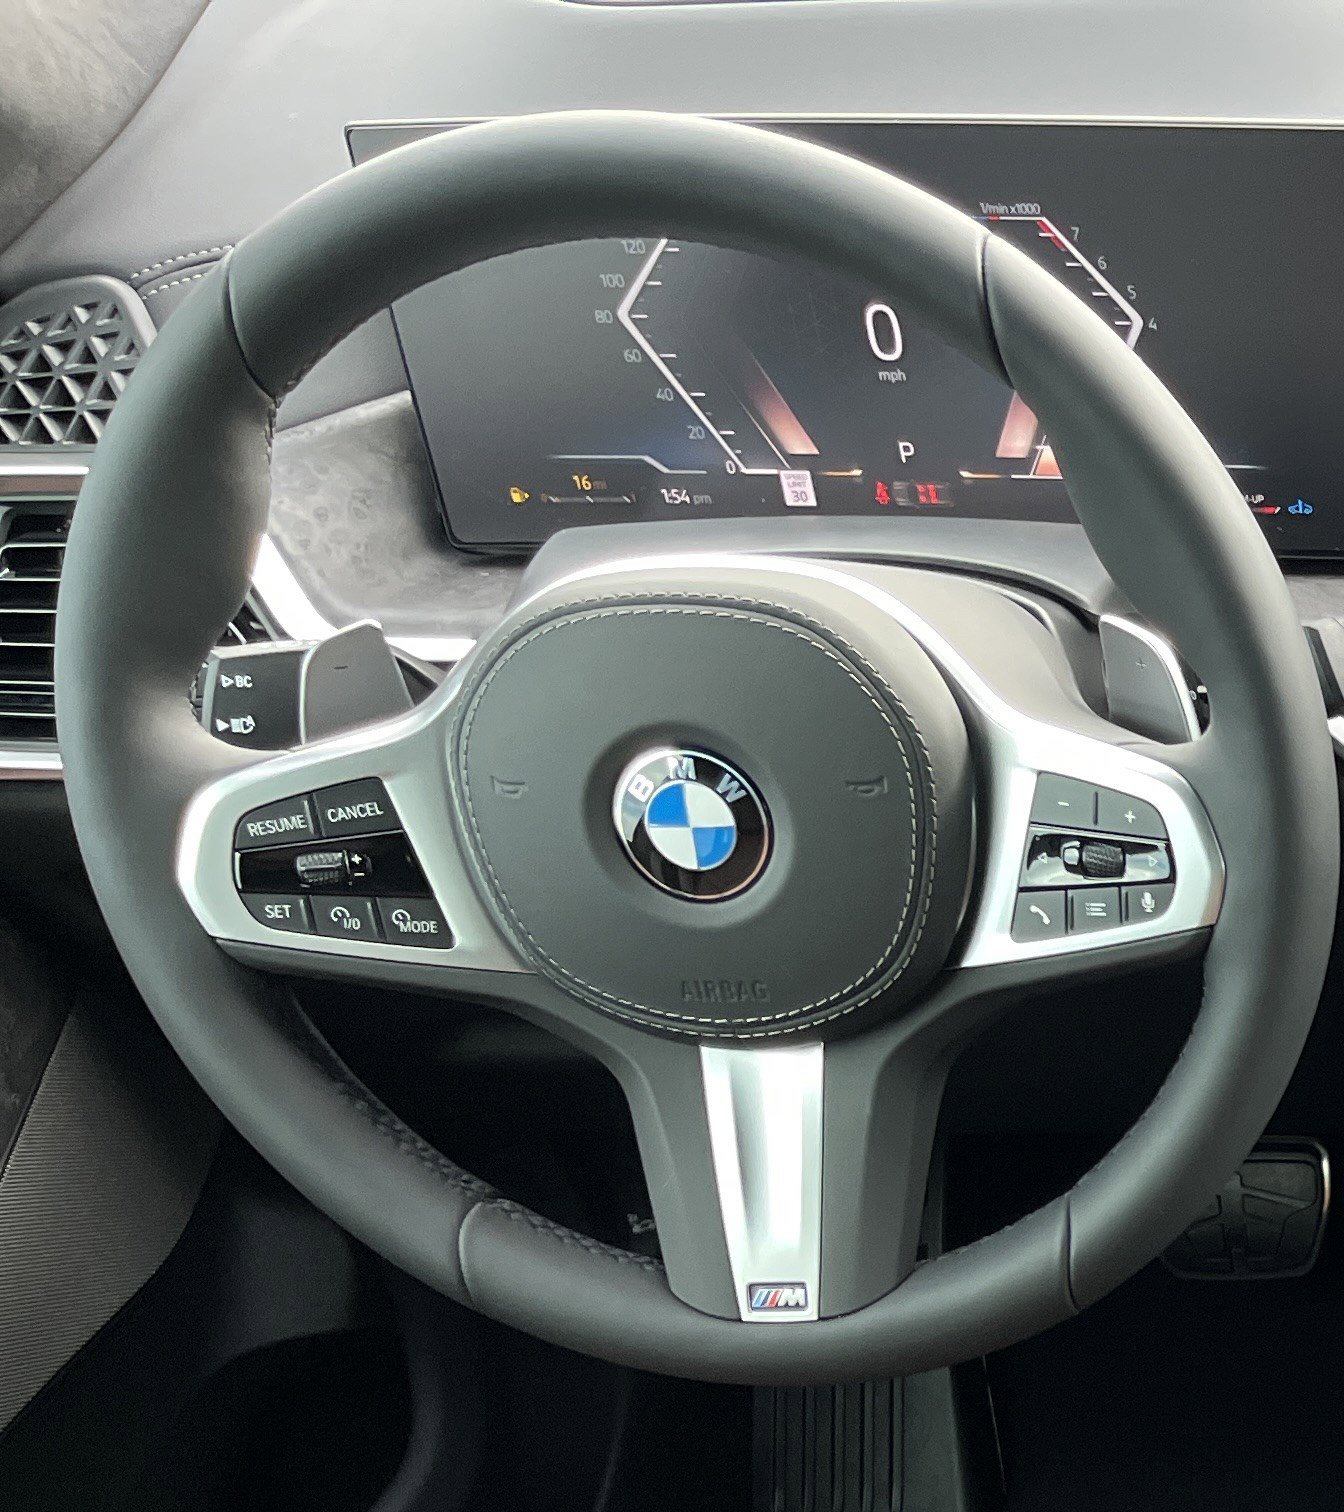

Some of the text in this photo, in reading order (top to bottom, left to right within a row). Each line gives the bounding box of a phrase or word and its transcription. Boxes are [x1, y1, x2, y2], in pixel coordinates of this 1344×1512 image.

[1071, 226, 1080, 242] 7
[621, 239, 646, 255] 120
[1098, 256, 1107, 270] 6
[600, 273, 625, 288] 100
[1127, 285, 1137, 300] 5
[595, 309, 613, 324] 80
[1148, 316, 1158, 330] 4
[866, 303, 903, 361] 0
[623, 349, 642, 363] 60
[878, 369, 907, 384] mph
[656, 388, 674, 401] 40
[688, 425, 705, 440] 20
[898, 440, 915, 463] P
[725, 460, 737, 475] 0
[572, 474, 592, 491] 16
[661, 488, 690, 504] 1:54
[791, 490, 808, 502] 30
[235, 674, 253, 688] BC
[627, 755, 747, 804] BMW
[327, 801, 384, 823] CANCEL
[247, 814, 308, 838] RESUME
[265, 904, 291, 919] SET
[399, 919, 439, 934] MODE
[681, 979, 770, 1002] AIRBAG
